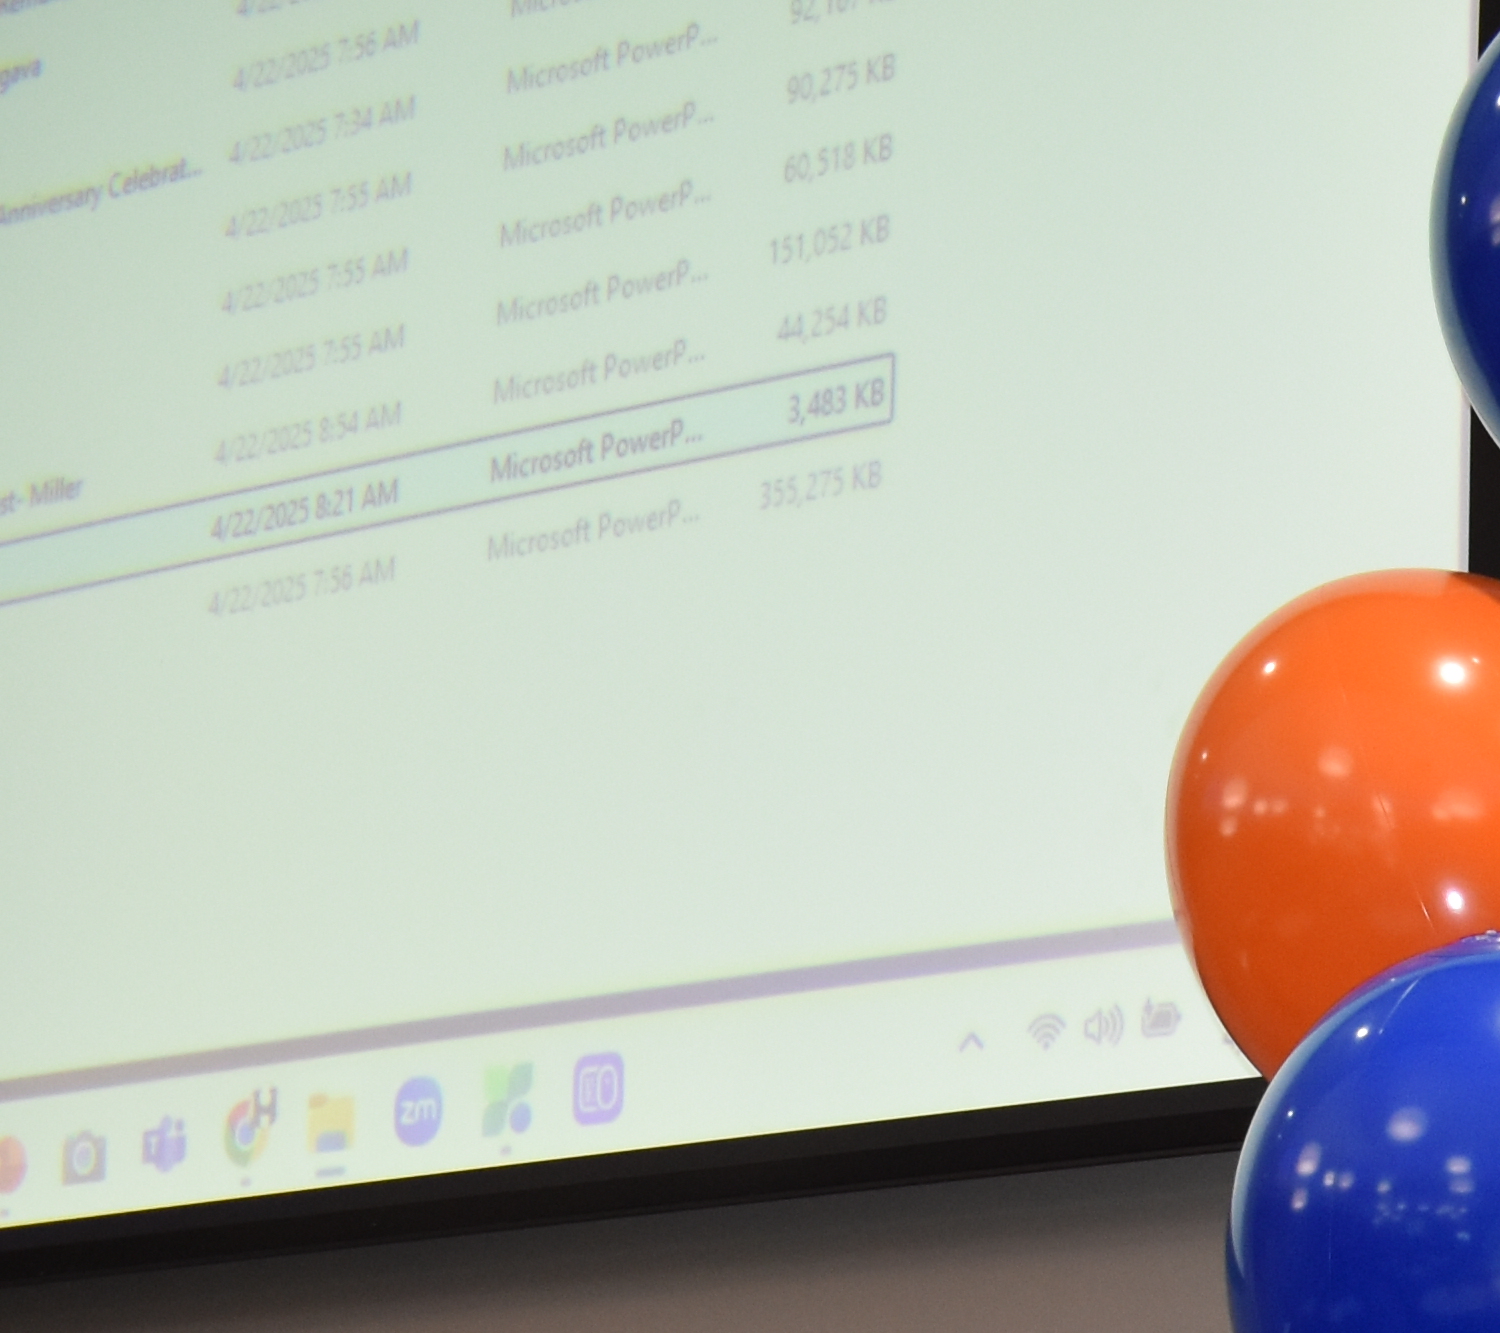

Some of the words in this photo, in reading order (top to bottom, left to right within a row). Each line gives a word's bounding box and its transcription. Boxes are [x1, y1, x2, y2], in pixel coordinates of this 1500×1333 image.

[383, 19, 419, 50] AM
[507, 46, 610, 94] Microsoft
[786, 61, 858, 104] 90,275
[865, 52, 897, 85] KB
[379, 95, 416, 124] AM
[503, 124, 607, 172] Microsoft
[783, 141, 855, 184] 60,518
[862, 133, 894, 166] KB
[376, 172, 412, 201] AM
[500, 203, 603, 248] Microsoft
[769, 223, 852, 266] 151,052
[860, 214, 891, 246] KB
[372, 248, 409, 277] AM
[496, 280, 599, 326] Microsoft
[776, 303, 849, 345] 44,254
[857, 295, 888, 326] KB
[368, 323, 405, 353] AM
[494, 358, 597, 405] Microsoft
[787, 384, 847, 427] 3,483
[854, 377, 885, 410] KB
[366, 401, 402, 429] AM
[490, 437, 594, 483] Microsoft
[361, 478, 399, 509] AM
[760, 466, 843, 511] 355,275
[852, 460, 882, 489] KB
[487, 518, 591, 562] Microsoft
[359, 556, 396, 585] AM
